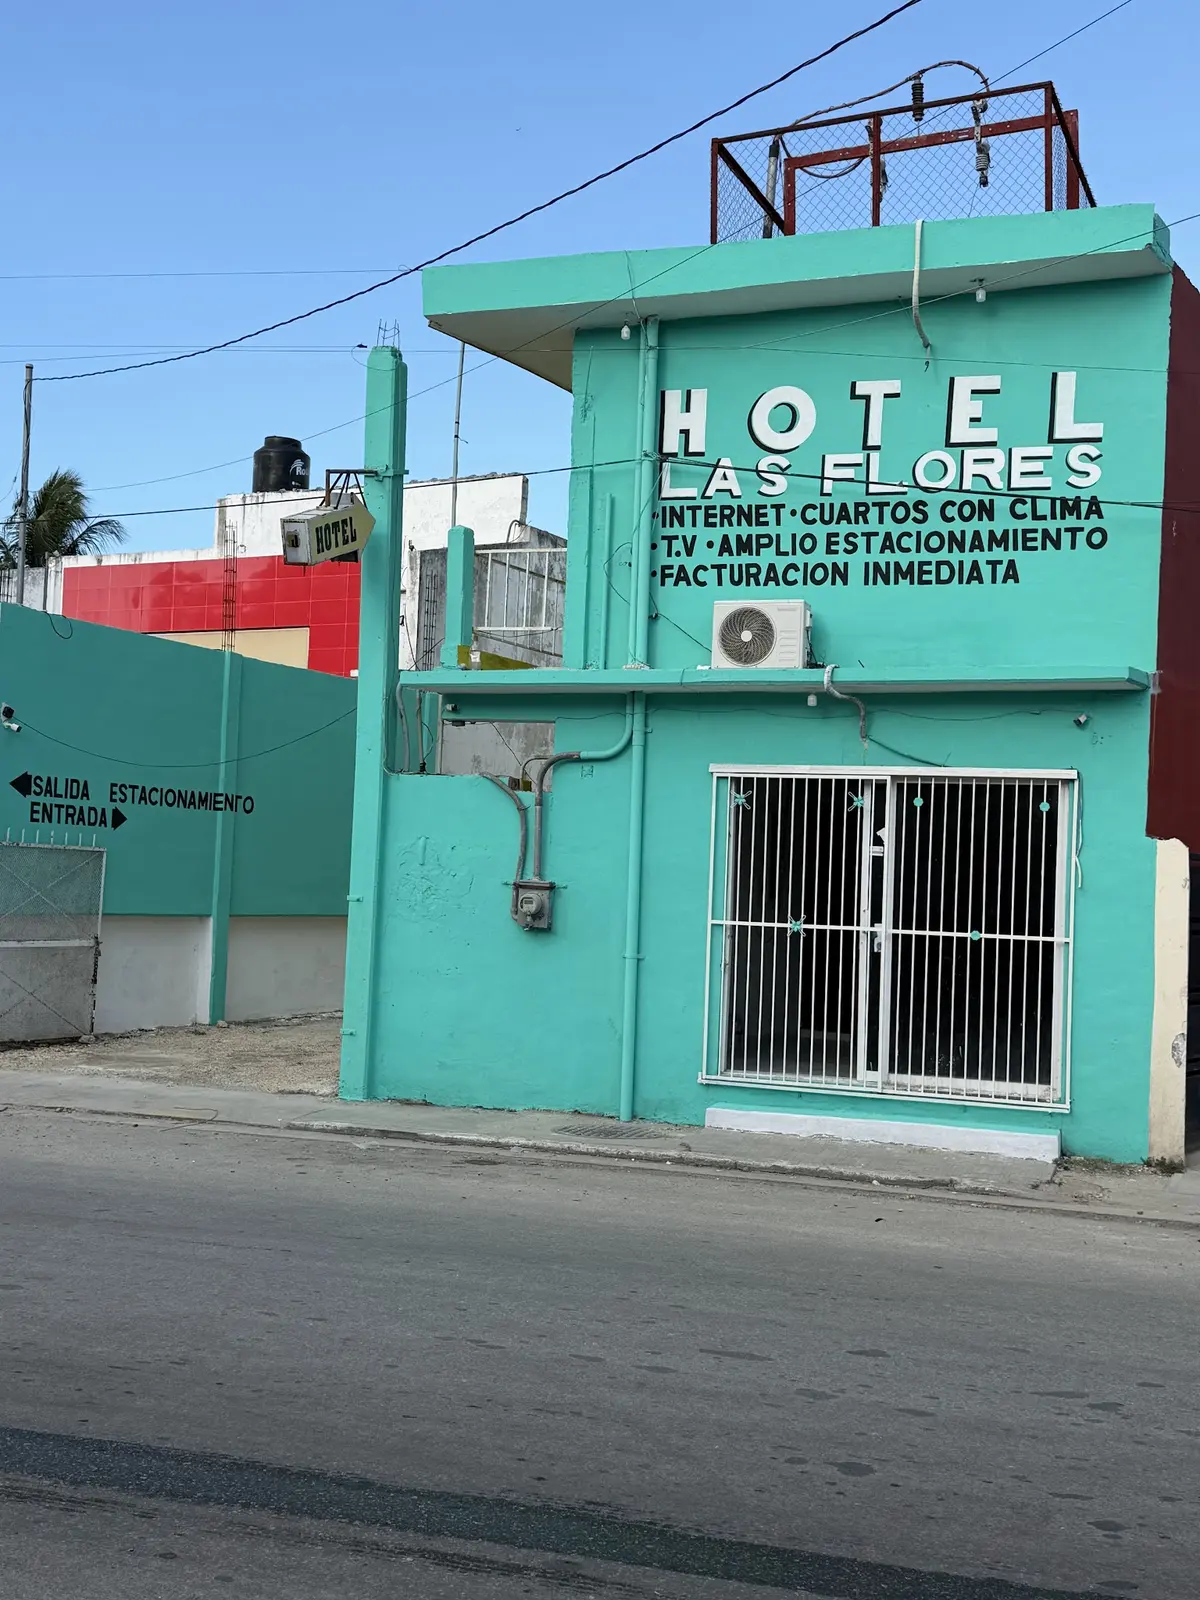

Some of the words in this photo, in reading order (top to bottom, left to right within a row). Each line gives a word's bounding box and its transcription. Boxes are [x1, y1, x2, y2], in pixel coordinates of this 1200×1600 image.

[659, 371, 1104, 457] HOTEL
[659, 453, 792, 500] LAS
[820, 443, 1103, 496] FLORES
[660, 504, 786, 528] INTERNET
[801, 500, 929, 526] CUARTOS
[939, 498, 995, 524] CON
[1009, 496, 1105, 522] CLIMA
[315, 516, 357, 554] HOTEL
[717, 532, 818, 557] AMPLIO
[825, 526, 1109, 555] ESTACIONAMIENTO
[660, 561, 849, 587] FACTURACION
[863, 559, 1020, 586] INMEDIATA
[33, 775, 90, 800] SALIDA
[109, 782, 255, 815] ESTACIONAMIENTO
[30, 801, 108, 828] ENTRADA
